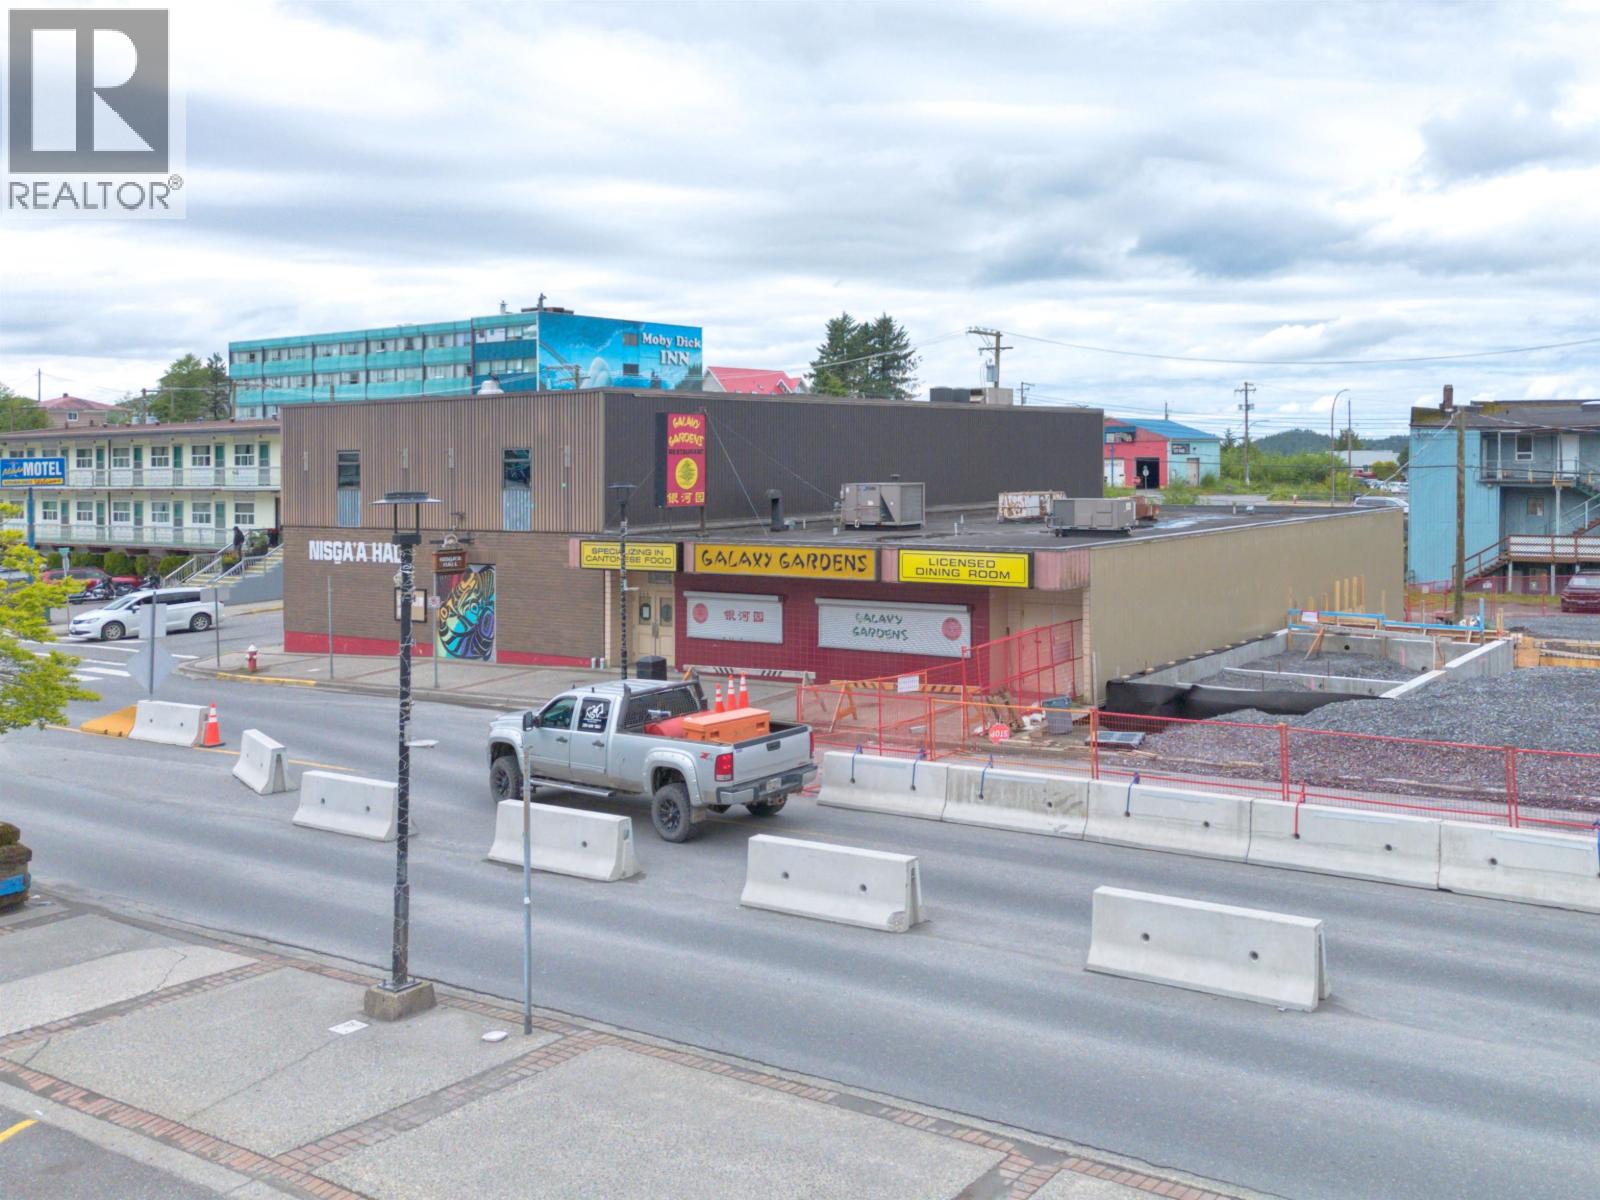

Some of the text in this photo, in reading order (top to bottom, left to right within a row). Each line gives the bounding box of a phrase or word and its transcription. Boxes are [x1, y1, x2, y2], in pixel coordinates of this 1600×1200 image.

[642, 332, 701, 348] Moby Dick
[660, 350, 690, 366] INN
[23, 461, 62, 476] MOTEL
[372, 542, 402, 564] HAL
[644, 557, 672, 565] FOOD
[701, 549, 867, 573] GALAXY GARDENS
[928, 557, 996, 569] LICENSED
[915, 567, 1011, 580] DINING ROOM
[852, 626, 909, 641] GARDENS
